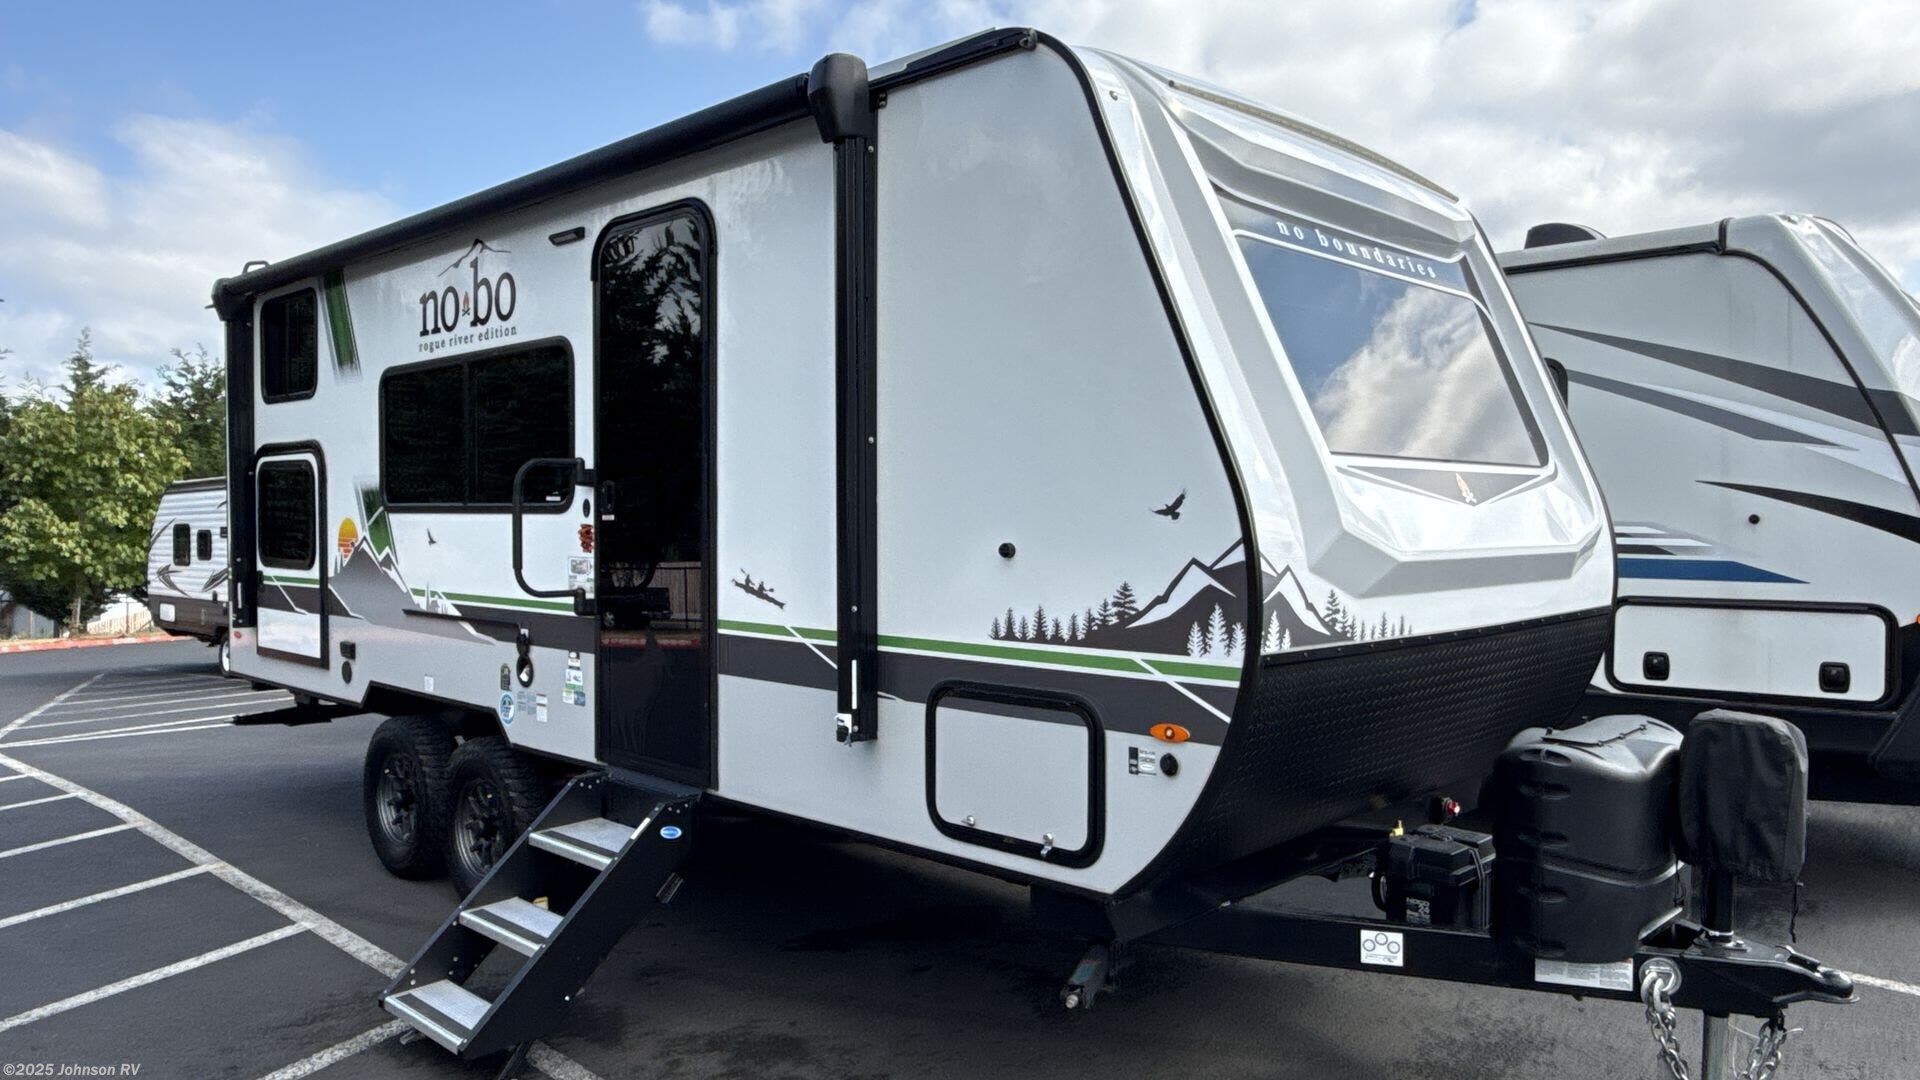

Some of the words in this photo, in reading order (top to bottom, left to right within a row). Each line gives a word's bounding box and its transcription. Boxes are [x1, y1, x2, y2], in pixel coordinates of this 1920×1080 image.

[1276, 220, 1304, 240] no
[1315, 230, 1436, 278] boundaries
[419, 339, 445, 354] rogue
[450, 333, 474, 347] river
[478, 325, 517, 341] edition
